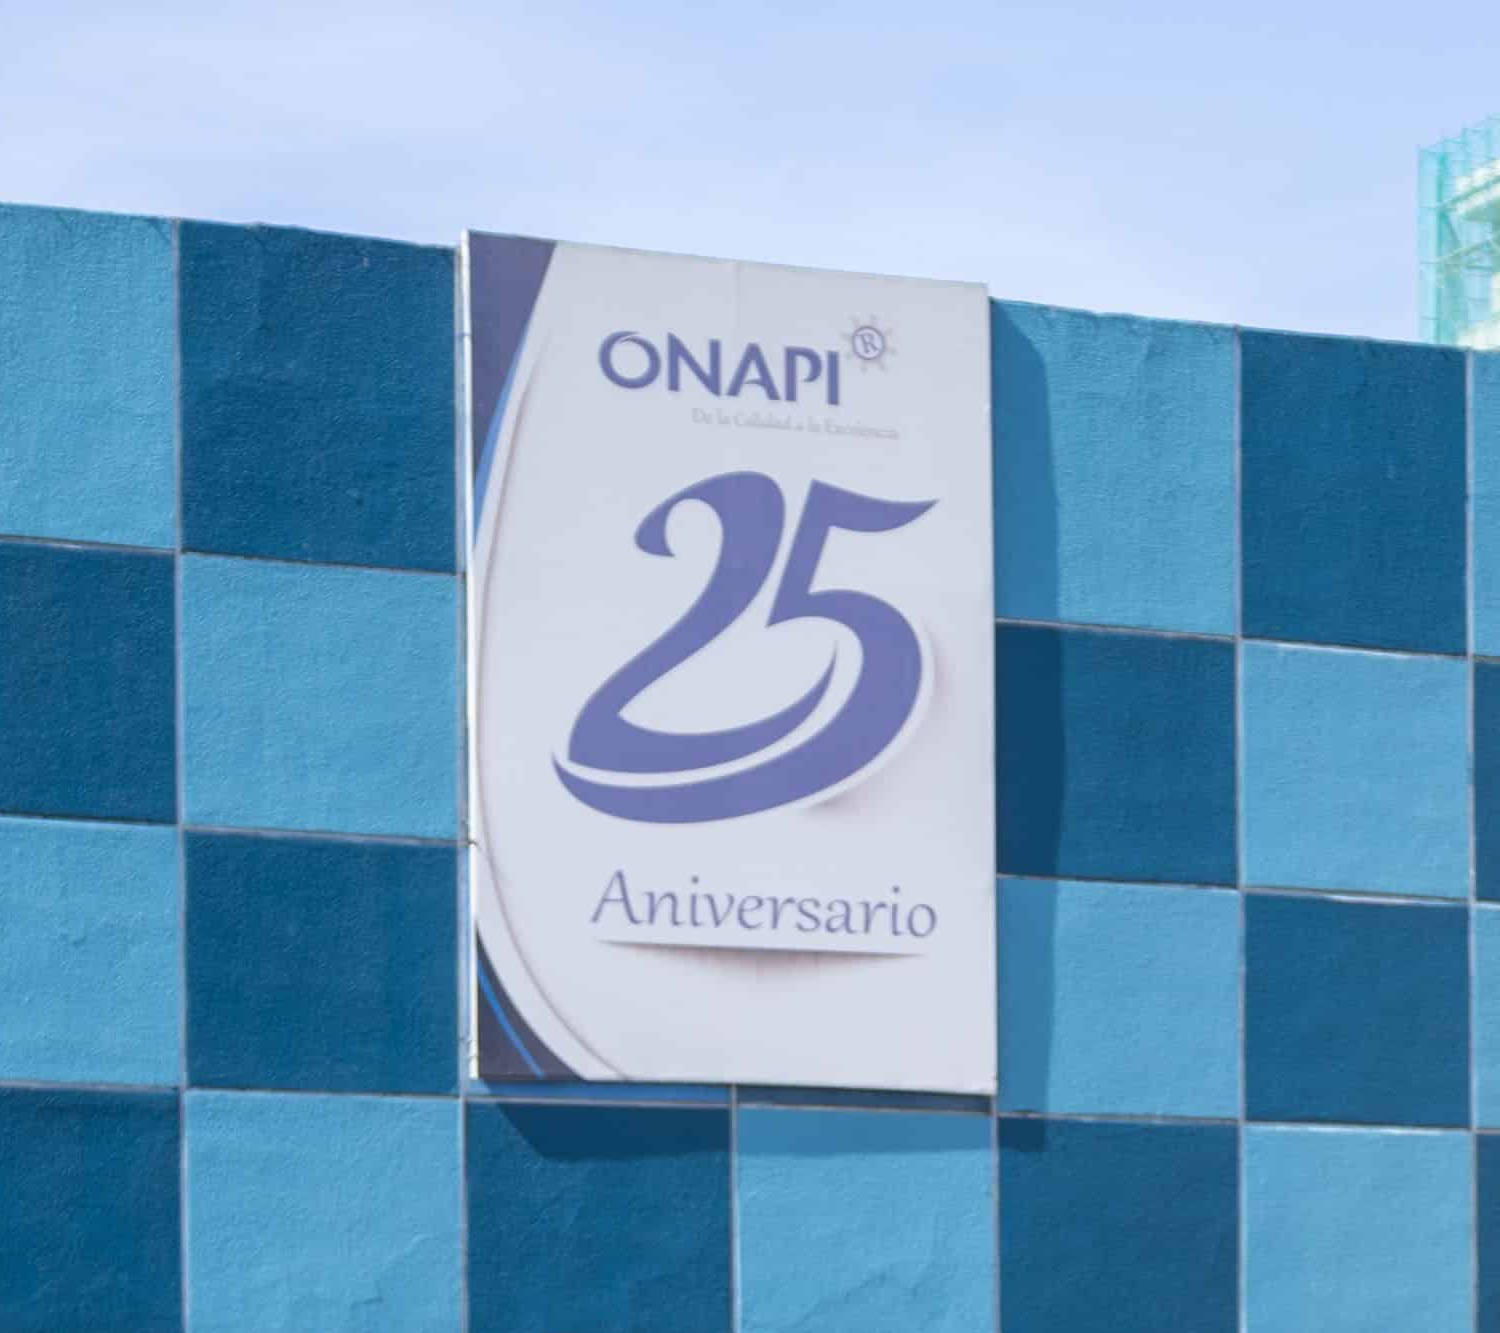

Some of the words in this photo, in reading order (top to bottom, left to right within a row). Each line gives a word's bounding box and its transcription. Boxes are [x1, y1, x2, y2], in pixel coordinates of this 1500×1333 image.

[597, 329, 840, 407] ONAPI
[551, 470, 941, 825] 25
[591, 868, 938, 939] Aniversario
